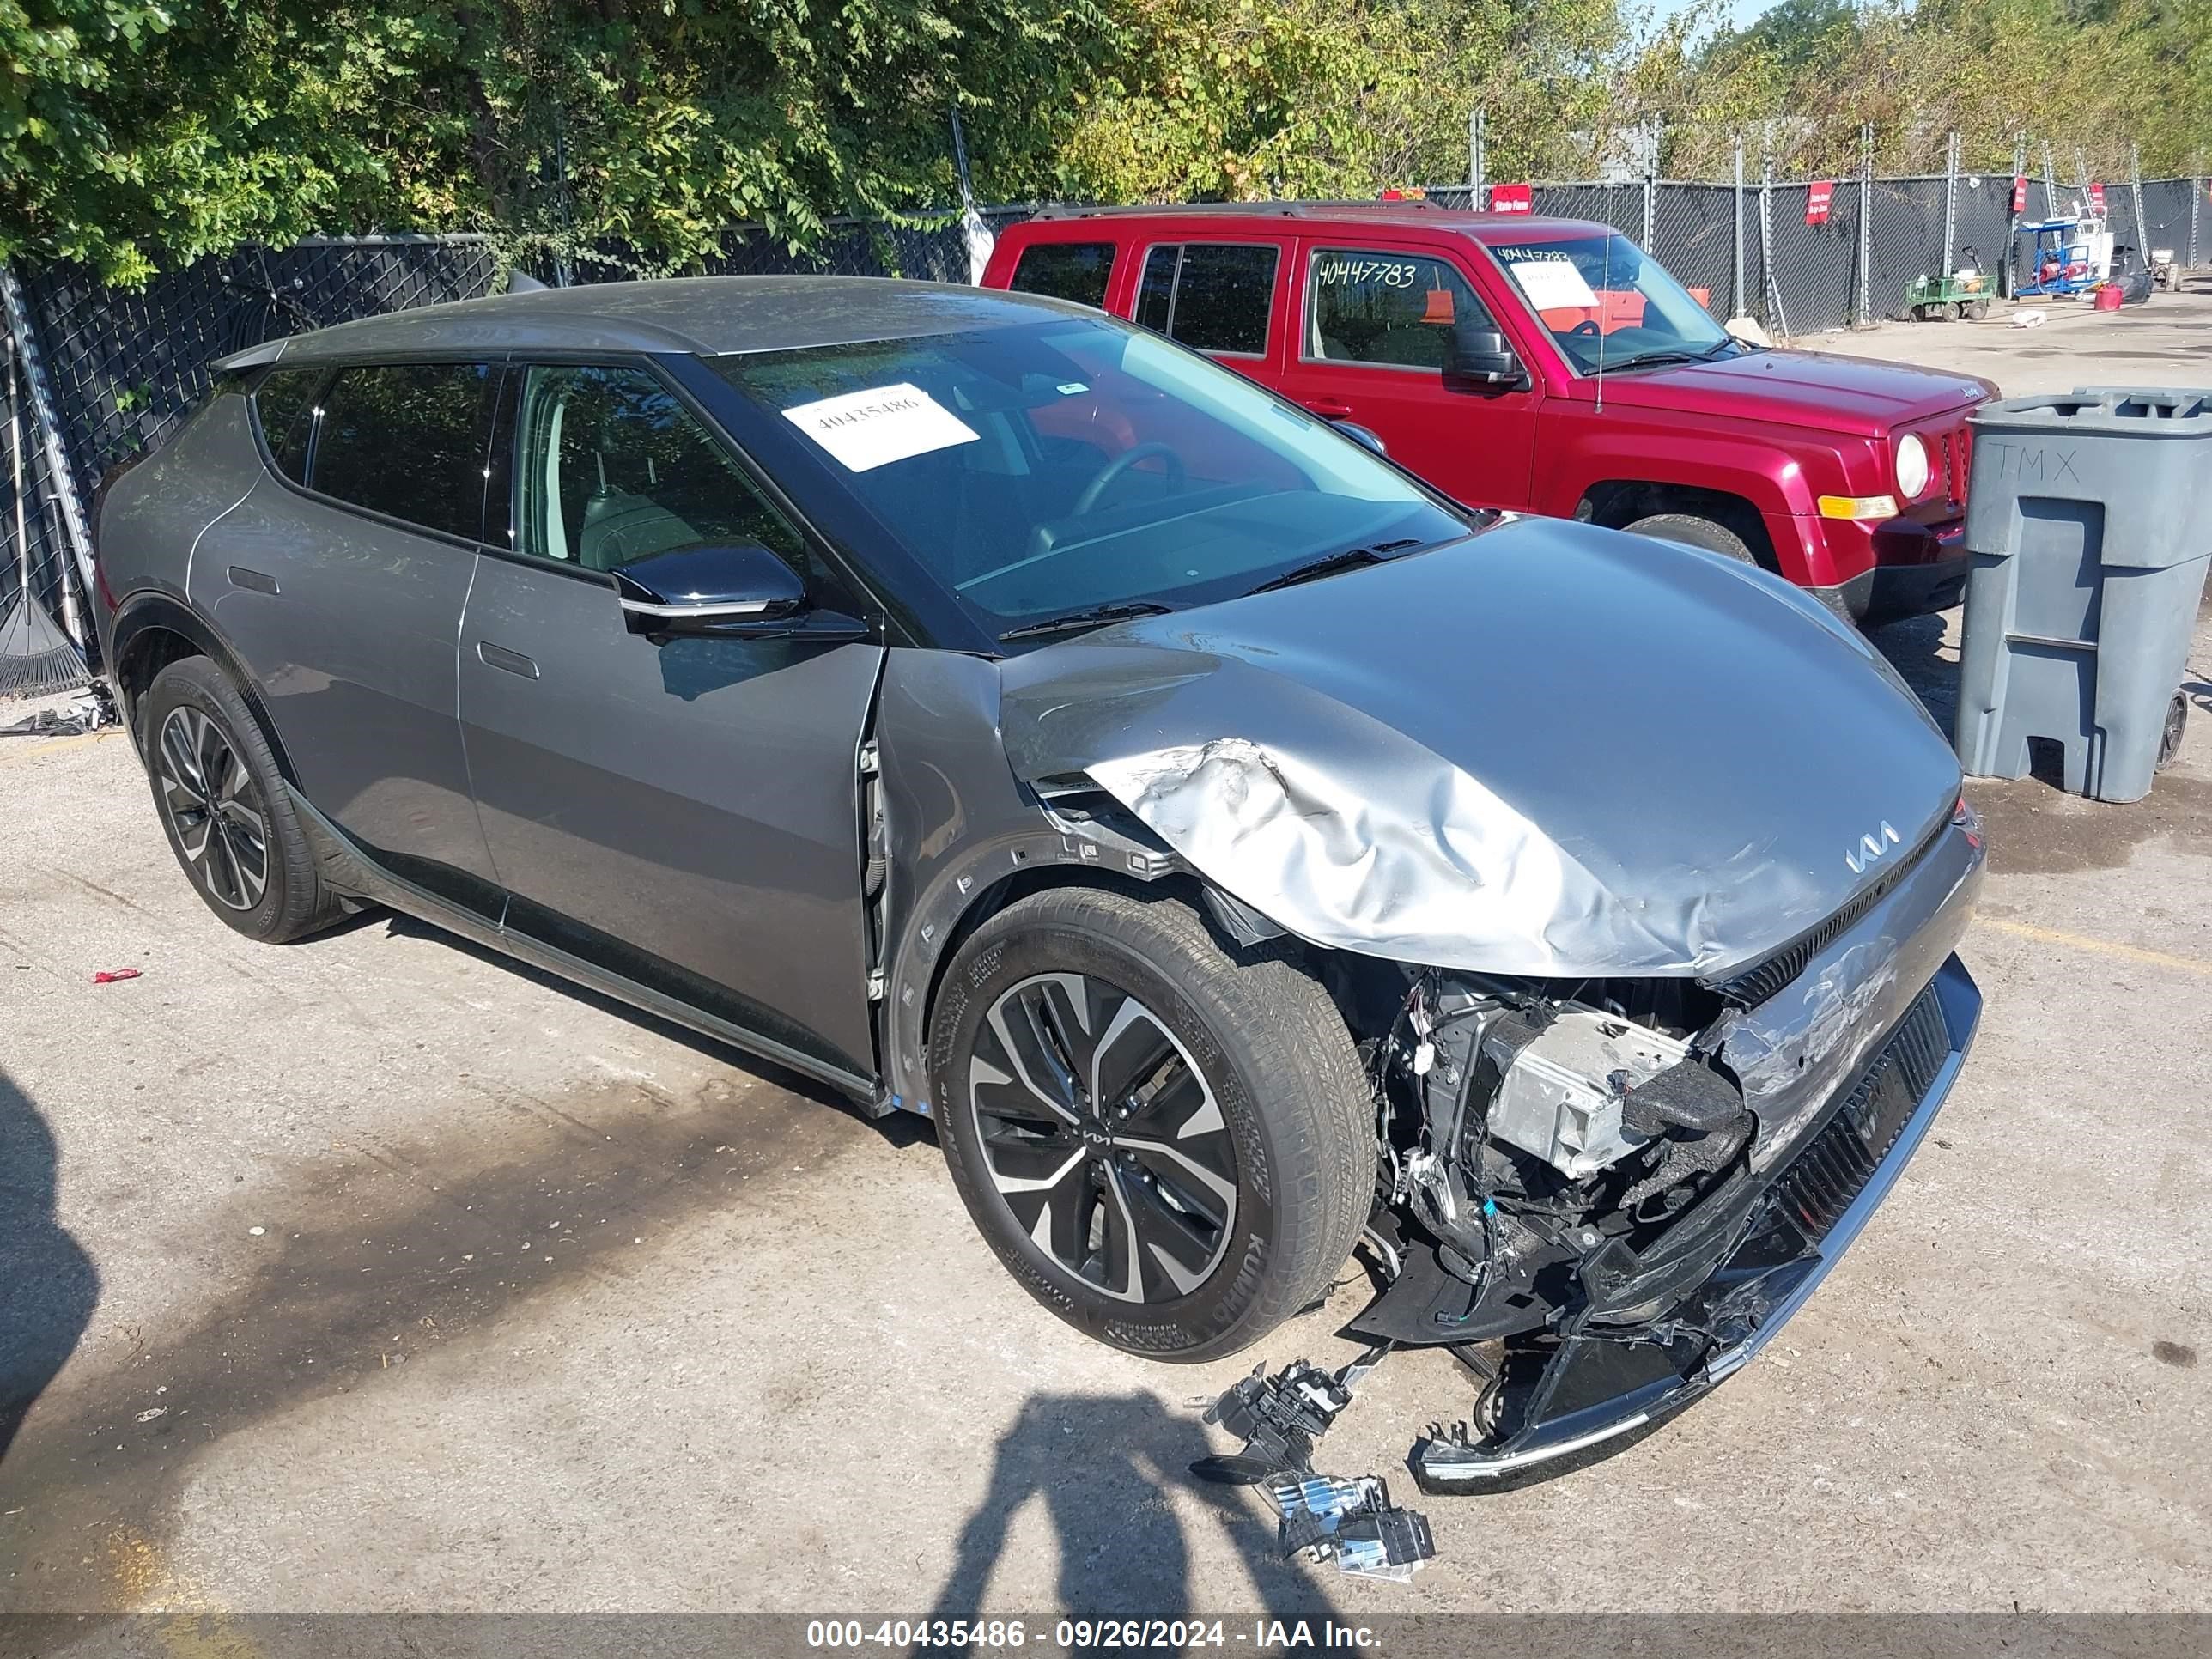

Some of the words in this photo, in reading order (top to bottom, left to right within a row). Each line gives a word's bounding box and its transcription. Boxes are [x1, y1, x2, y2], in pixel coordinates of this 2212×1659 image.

[1497, 247, 1571, 263] 40447783
[1319, 260, 1416, 289] 40447783
[818, 398, 920, 431] 40435486
[1987, 442, 2080, 483] TMX
[1212, 1232, 1265, 1322] KUMHO
